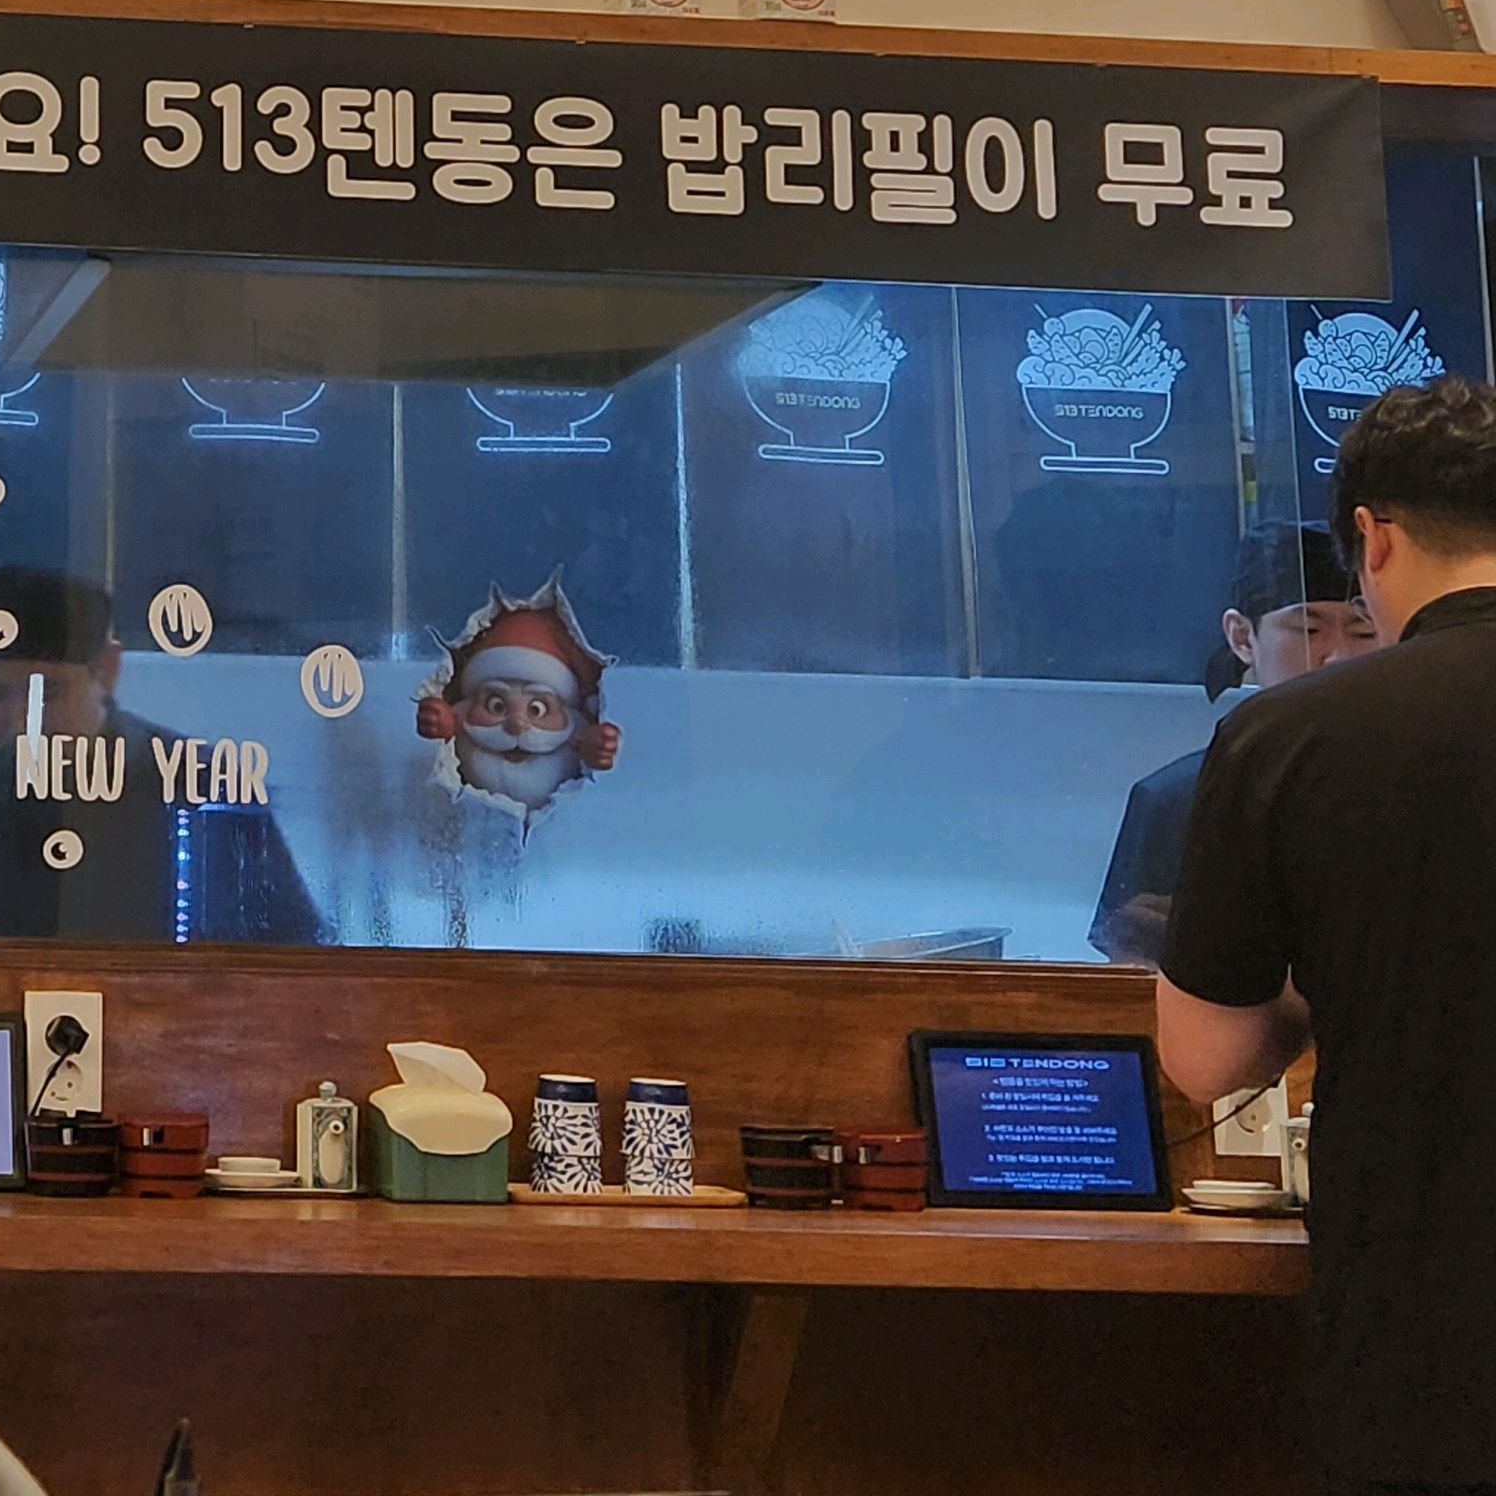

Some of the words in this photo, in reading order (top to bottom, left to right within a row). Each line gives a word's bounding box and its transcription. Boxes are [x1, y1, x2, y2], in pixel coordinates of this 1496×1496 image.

[143, 80, 623, 210] 513텐동은
[661, 103, 1057, 224] 밥리필이
[1097, 122, 1294, 228] 무료
[15, 733, 126, 803] NEW
[151, 736, 269, 805] YEAR
[1008, 1058, 1110, 1070] TENDONG
